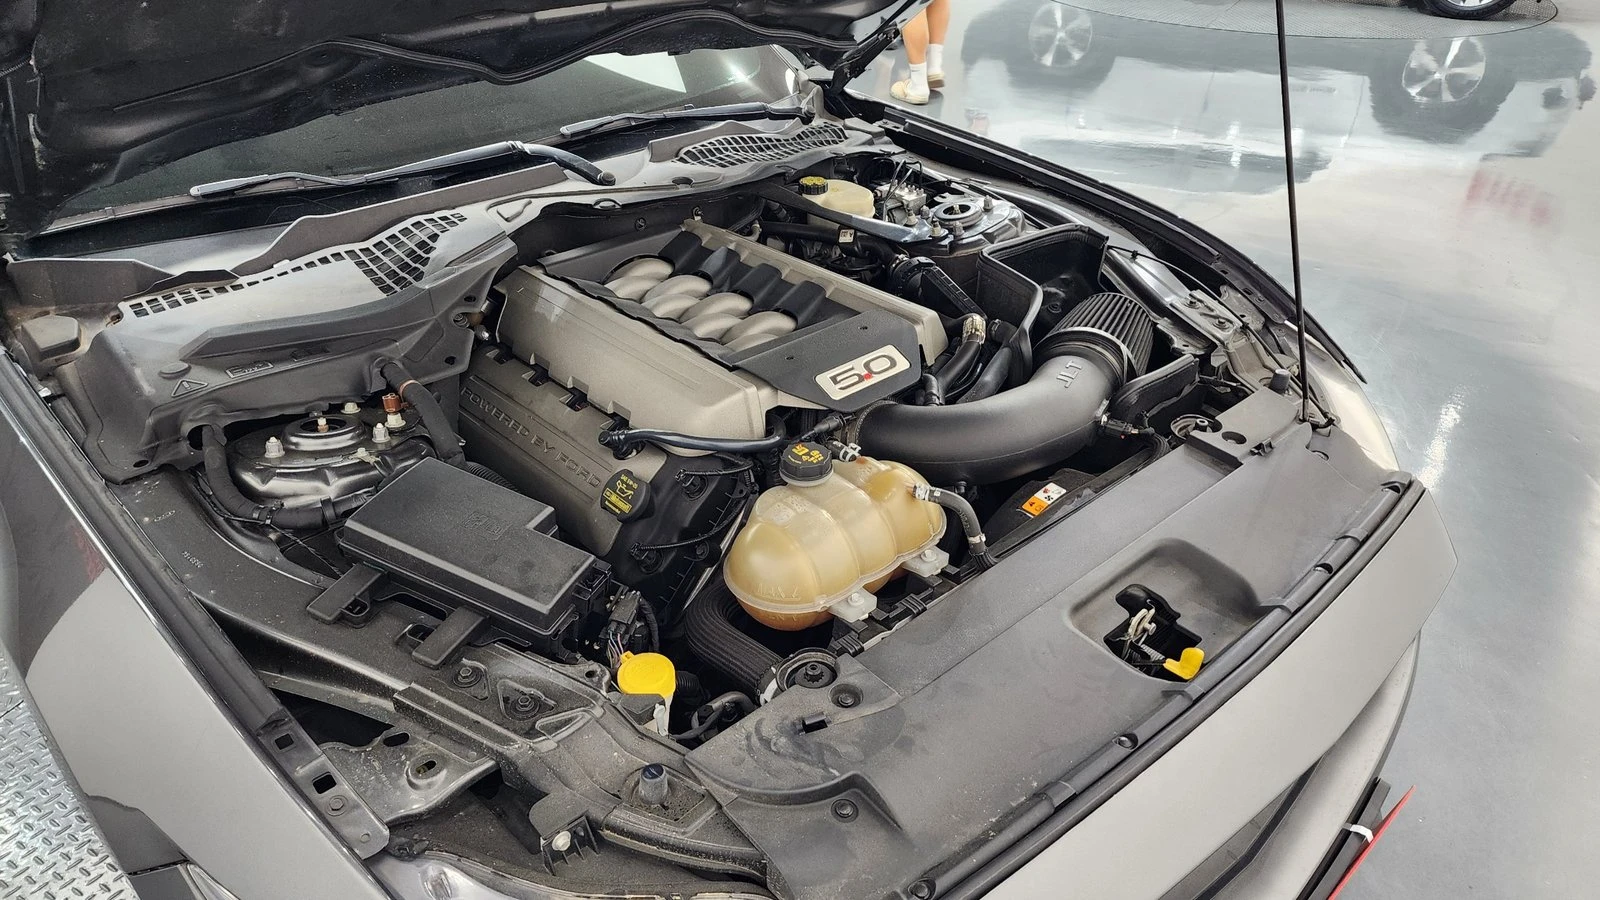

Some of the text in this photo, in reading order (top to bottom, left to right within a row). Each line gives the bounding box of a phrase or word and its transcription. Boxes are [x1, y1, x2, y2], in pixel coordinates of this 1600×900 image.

[828, 354, 898, 391] 5.0
[460, 386, 601, 489] POWERED BY FORD
